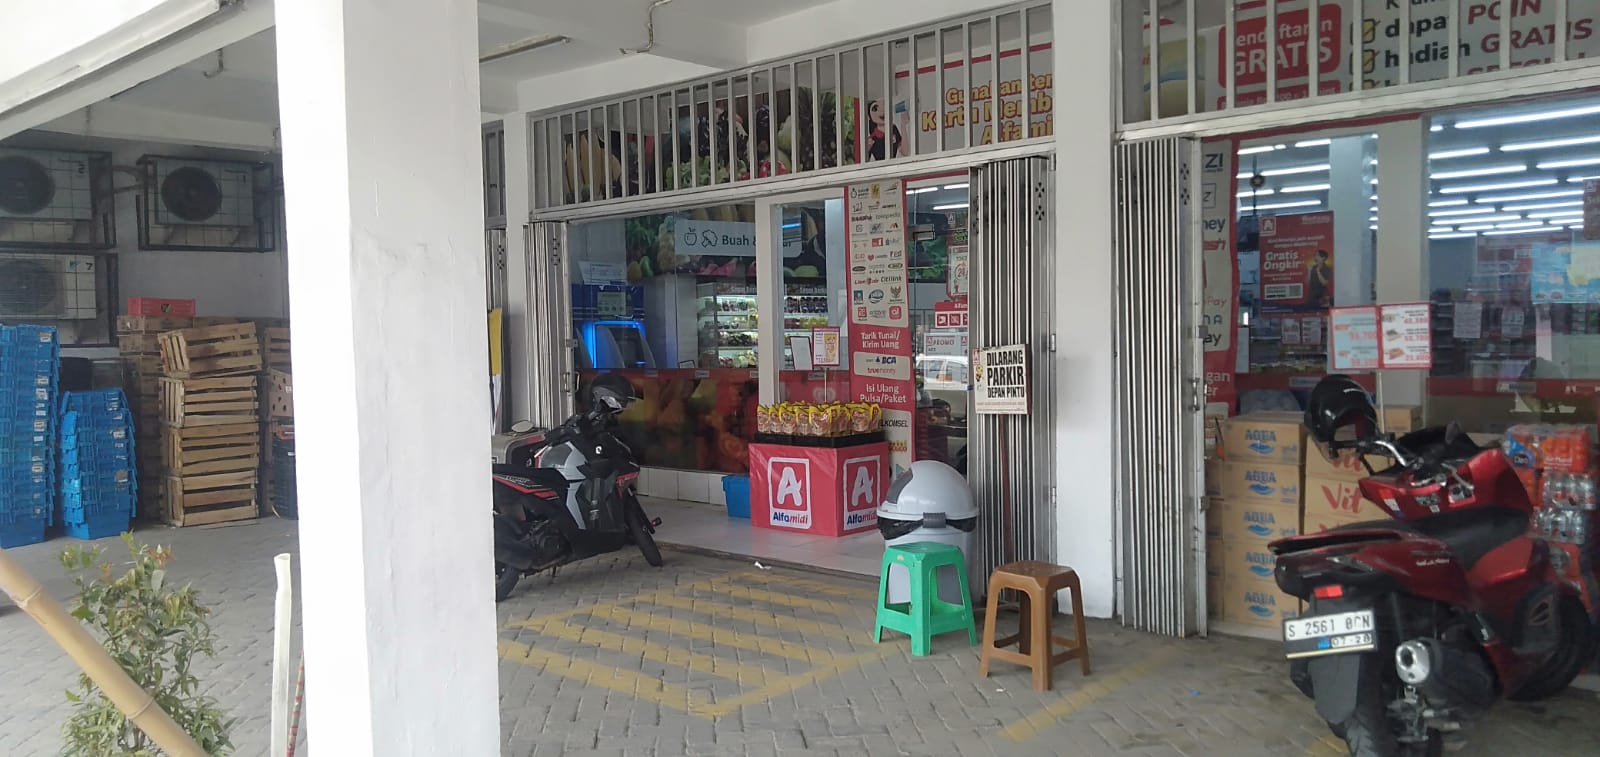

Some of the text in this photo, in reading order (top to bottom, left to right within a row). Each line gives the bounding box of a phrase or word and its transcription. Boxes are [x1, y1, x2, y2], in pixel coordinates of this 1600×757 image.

[722, 235, 749, 246] Buah
[1265, 250, 1298, 261] Gratis
[1263, 259, 1301, 271] Ongkir
[861, 330, 900, 341] Tarik Tunai/
[862, 340, 899, 350] Kirim Uang
[987, 350, 1023, 366] DILARANG
[987, 366, 1024, 386] PARKIR
[866, 384, 899, 394] Isi Ulang
[987, 387, 1024, 398] DEPAN PINTU
[860, 394, 906, 404] Pulsa/Paket
[1245, 430, 1276, 442] AQUA
[1245, 471, 1276, 483] AQUA
[1321, 484, 1363, 514] Vit
[773, 511, 808, 524] Alfamidi
[1243, 512, 1275, 524] AQUA
[1245, 553, 1275, 565] AQUA
[1245, 593, 1275, 605] AQUA
[1288, 625, 1295, 637] S
[1305, 619, 1334, 636] 2561
